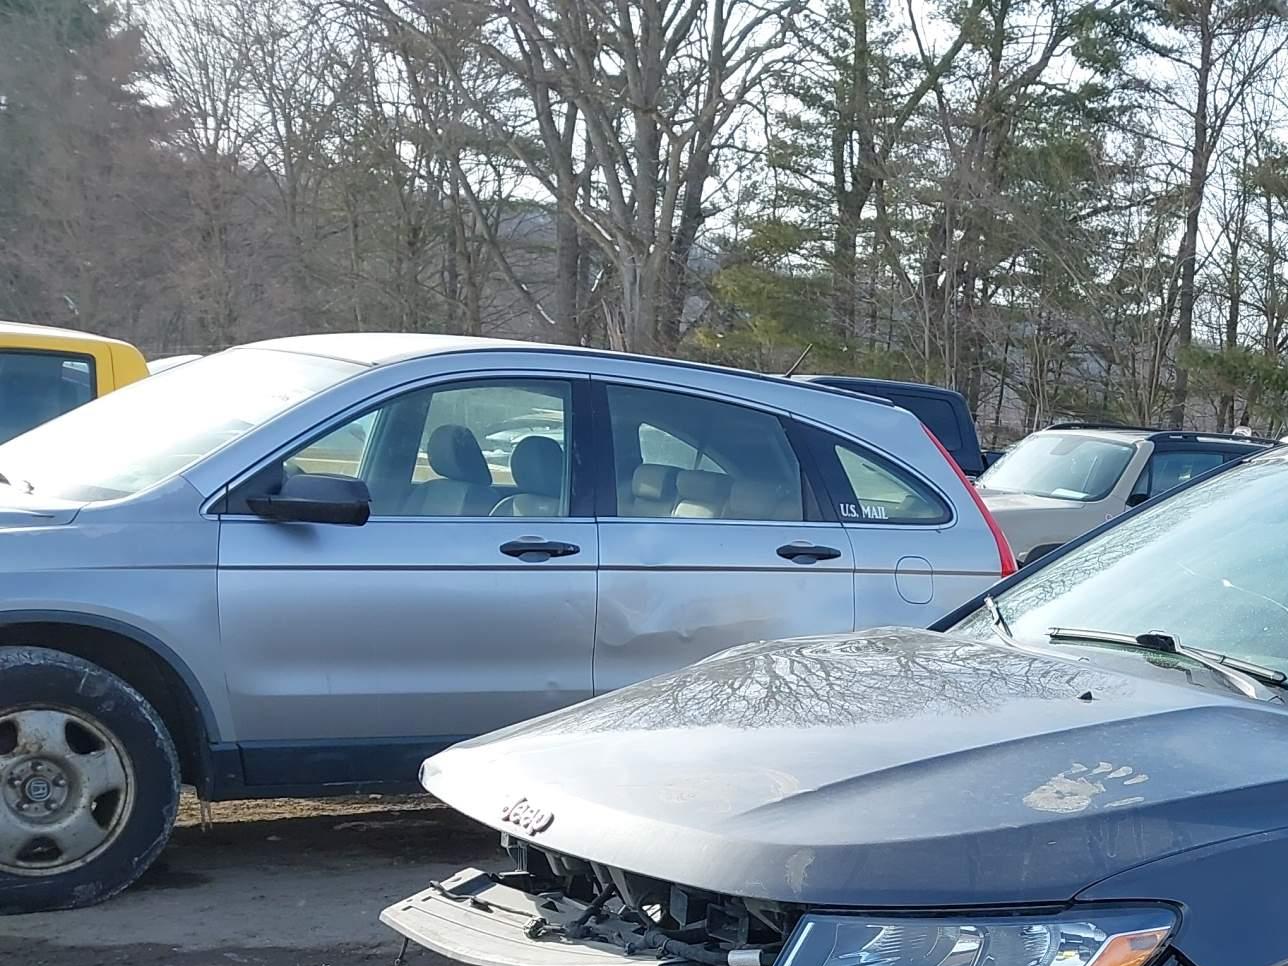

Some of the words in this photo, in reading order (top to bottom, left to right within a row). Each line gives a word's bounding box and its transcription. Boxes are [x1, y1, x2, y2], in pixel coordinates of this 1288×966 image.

[840, 503, 859, 518] U.S.
[862, 505, 889, 520] MAIL
[501, 797, 555, 836] Jeep
